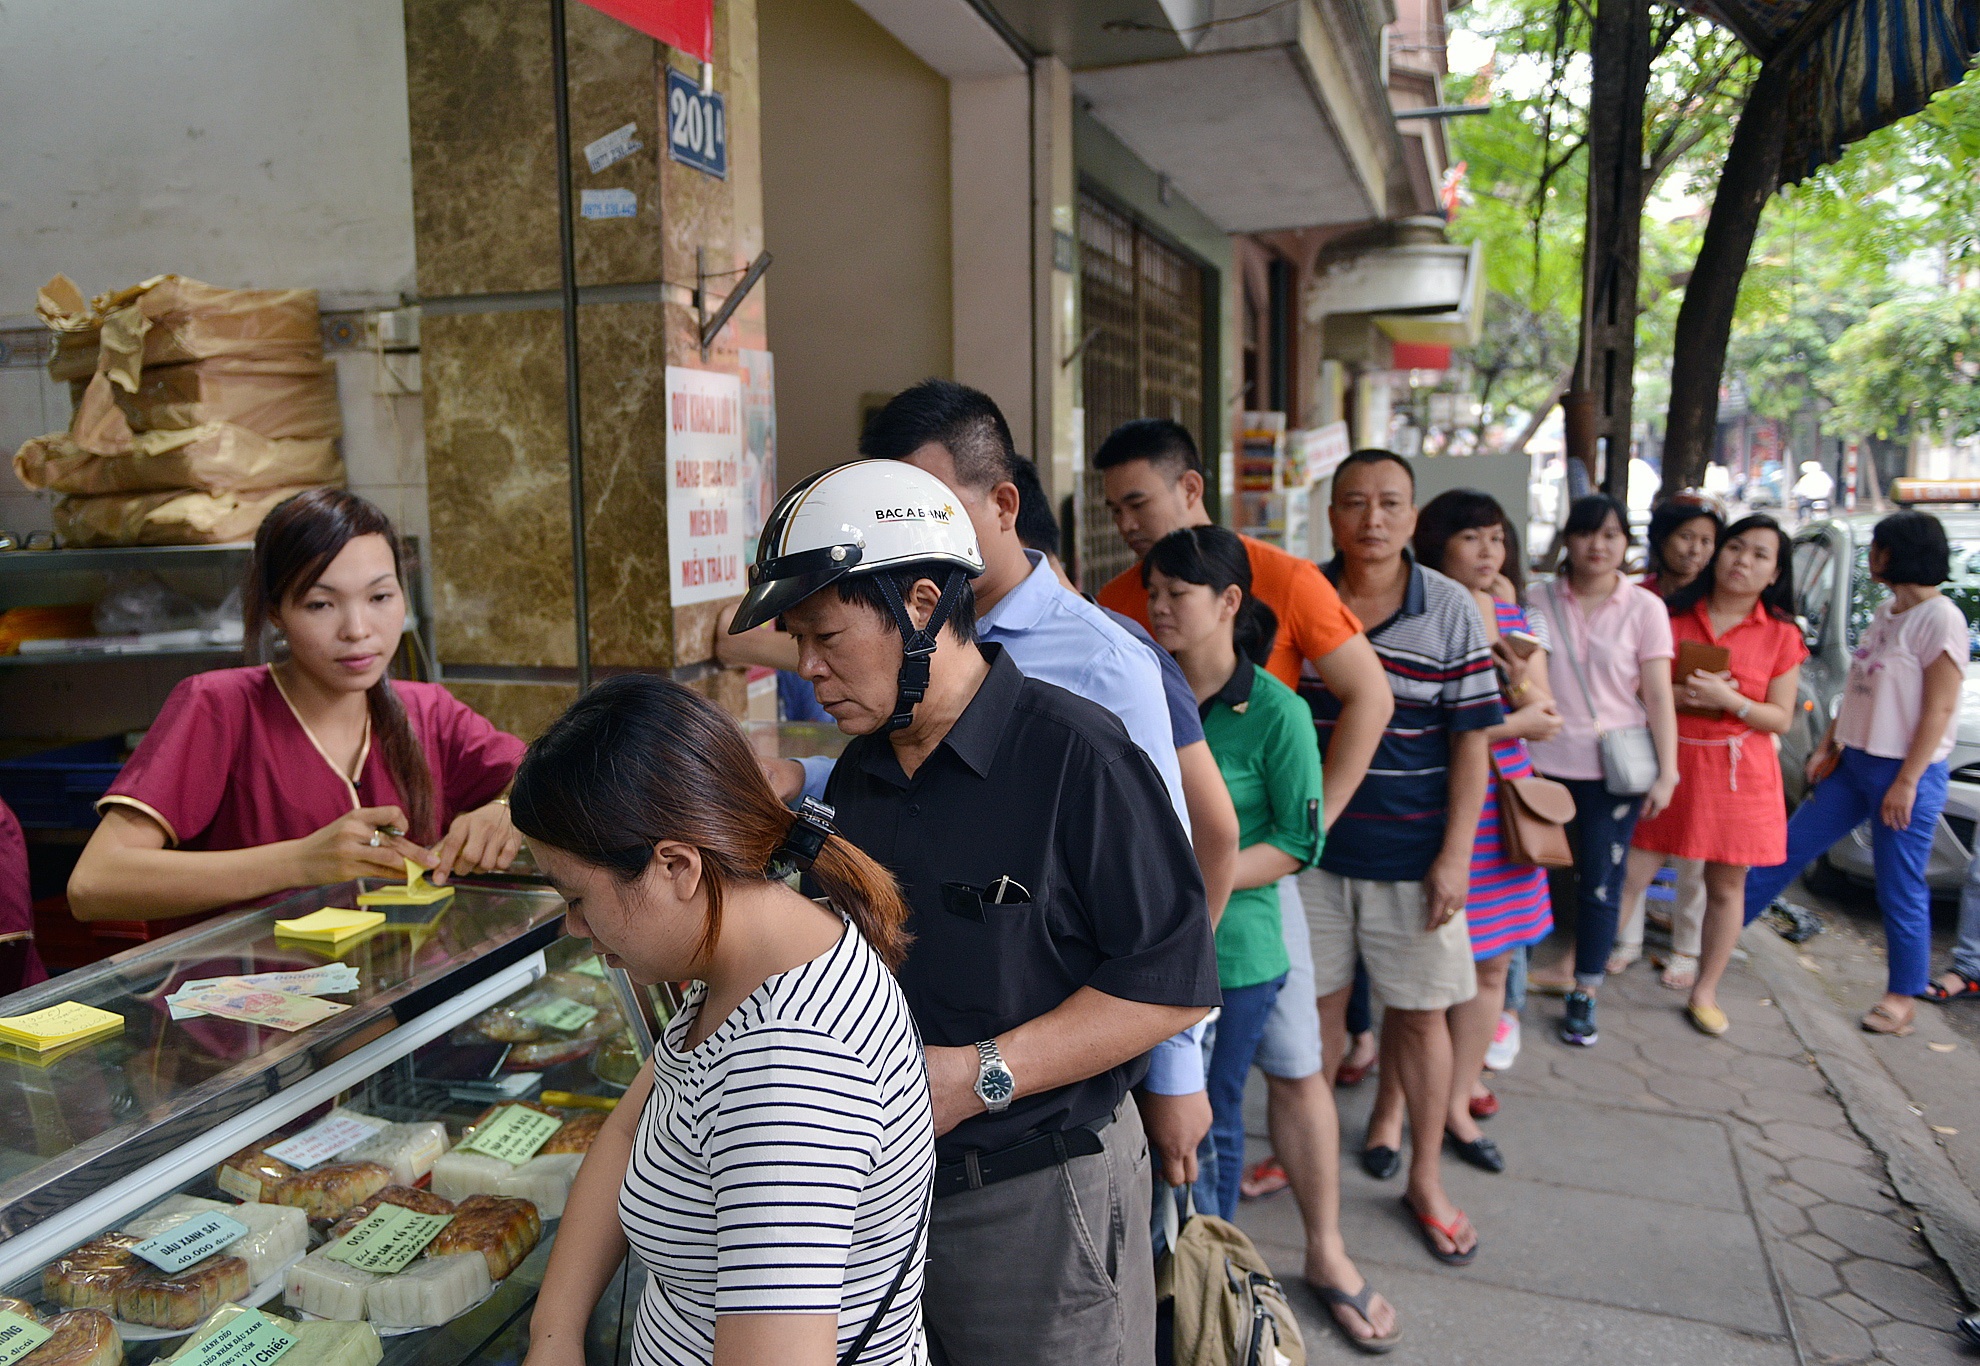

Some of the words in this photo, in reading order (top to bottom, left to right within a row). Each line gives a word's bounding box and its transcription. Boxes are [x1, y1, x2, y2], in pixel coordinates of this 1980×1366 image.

[875, 508, 904, 520] BAC
[906, 508, 916, 517] A
[180, 1230, 206, 1246] XANH
[178, 1243, 214, 1264] 40.000
[202, 1339, 220, 1354] BÁNH
[218, 1330, 232, 1342] DẺO
[216, 1342, 234, 1357] NHÂN
[245, 1321, 263, 1336] XANH
[256, 1337, 289, 1363] Chiếc
